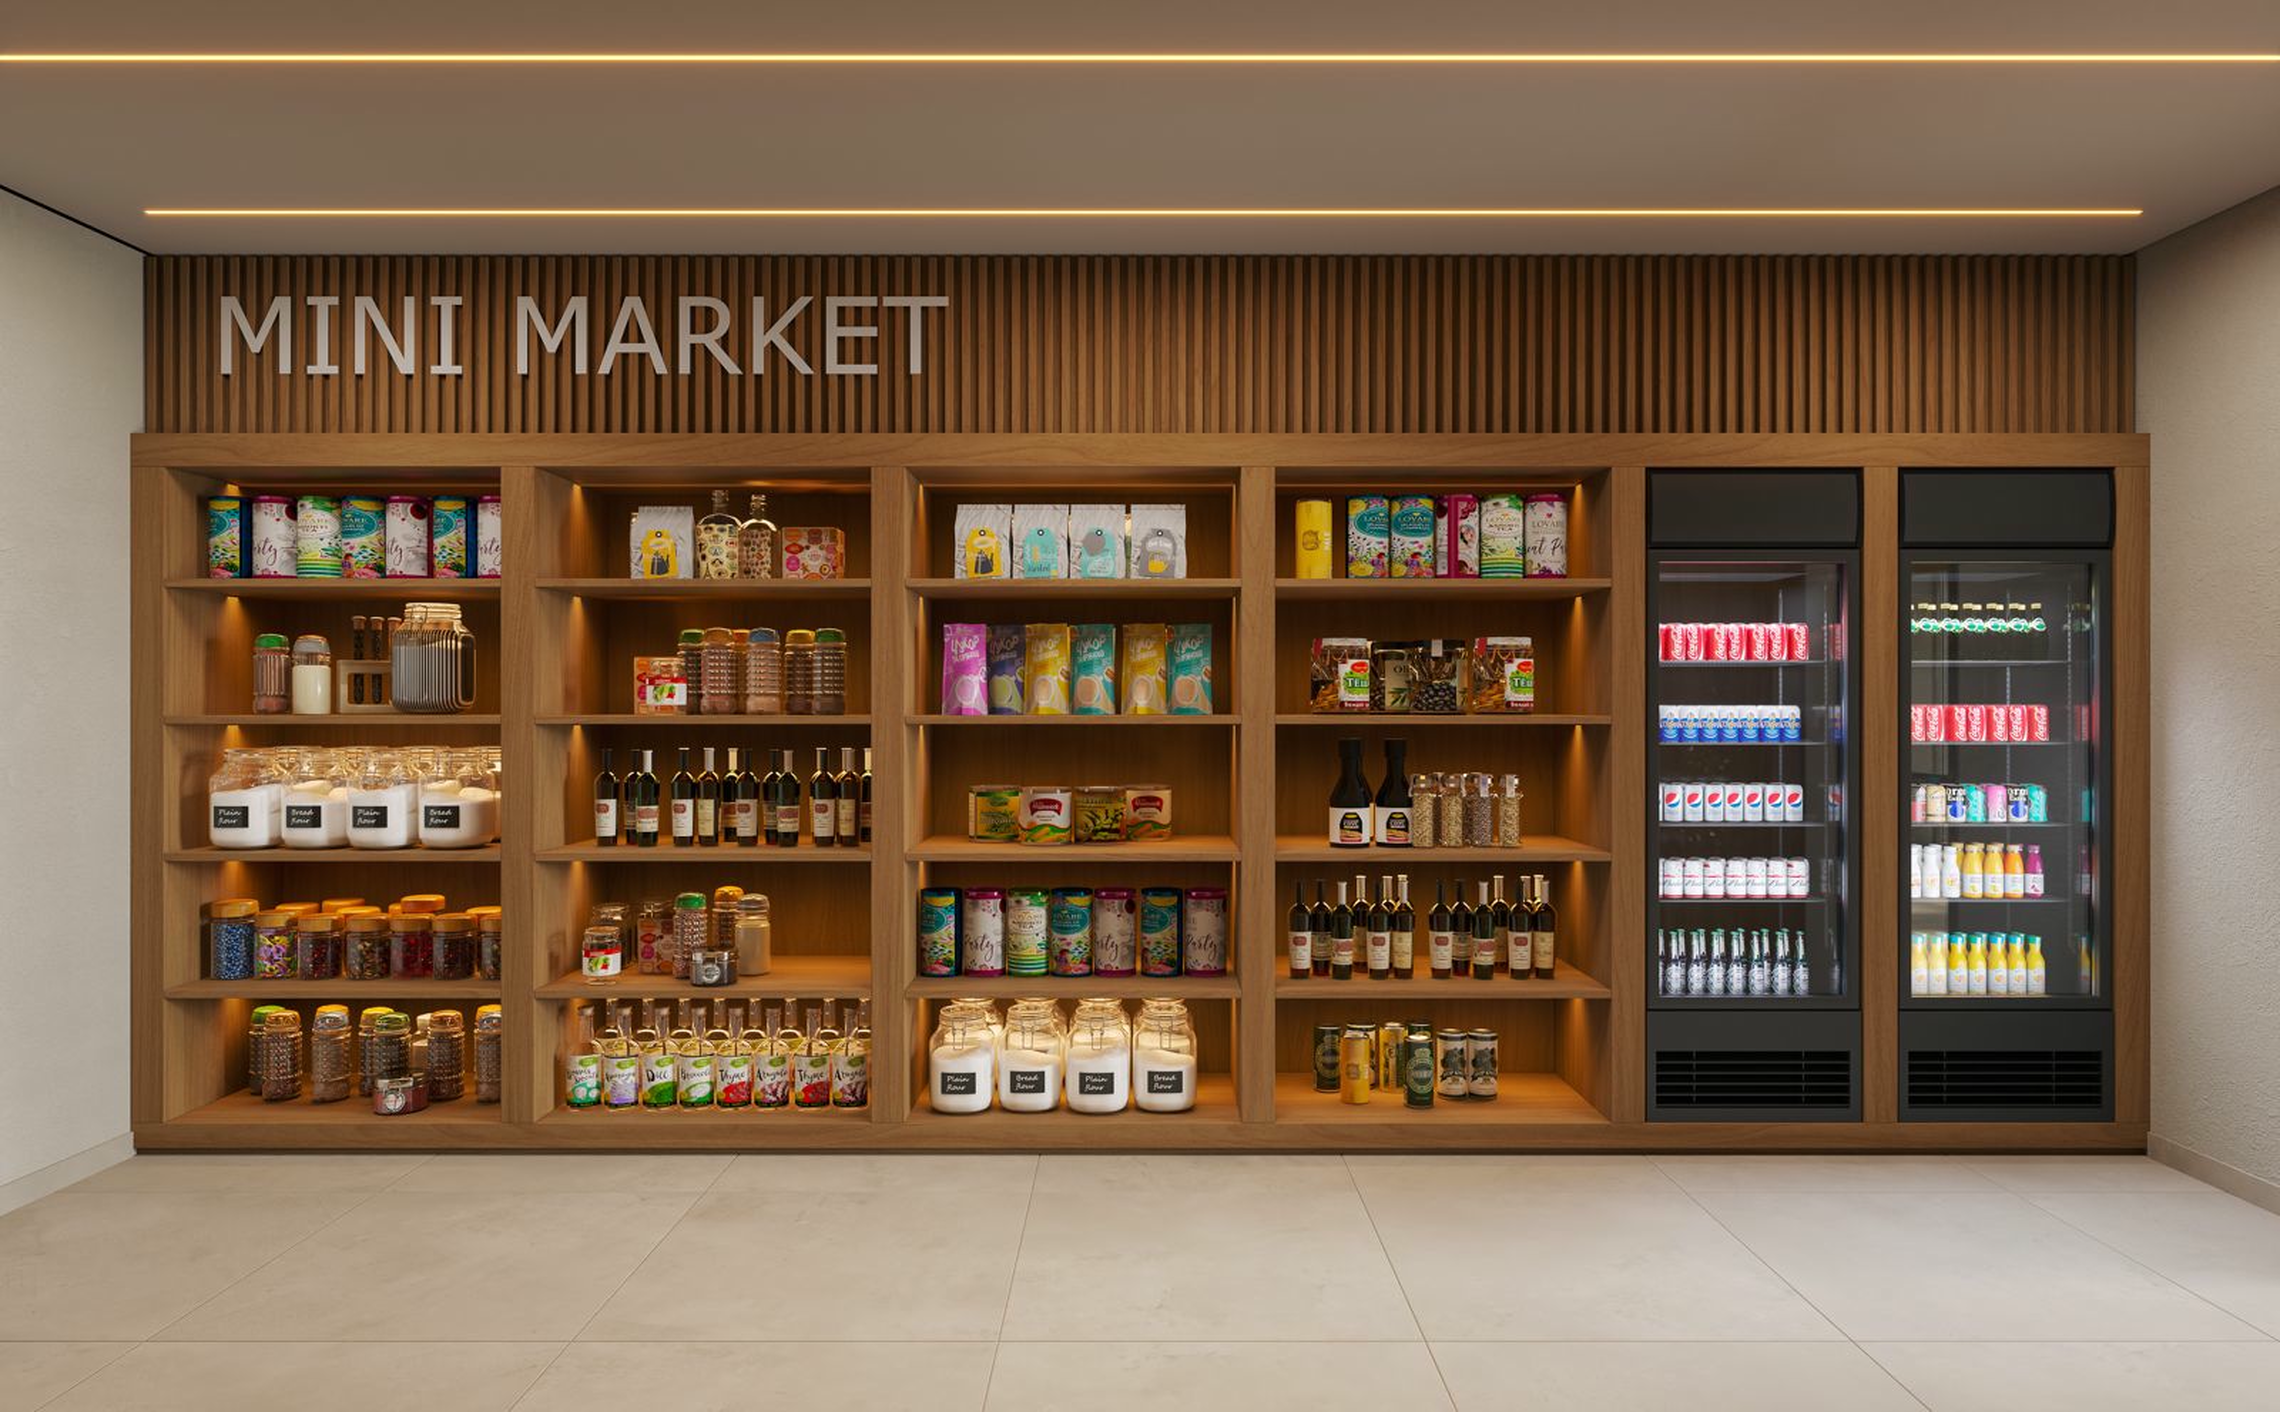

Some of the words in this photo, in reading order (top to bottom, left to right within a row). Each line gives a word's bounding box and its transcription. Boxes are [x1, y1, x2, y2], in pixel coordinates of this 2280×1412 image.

[220, 296, 462, 375] MINI
[516, 296, 949, 375] MARKET
[646, 1069, 669, 1082] Dill
[719, 1069, 745, 1083] Thyme
[798, 1069, 824, 1083] Thyme
